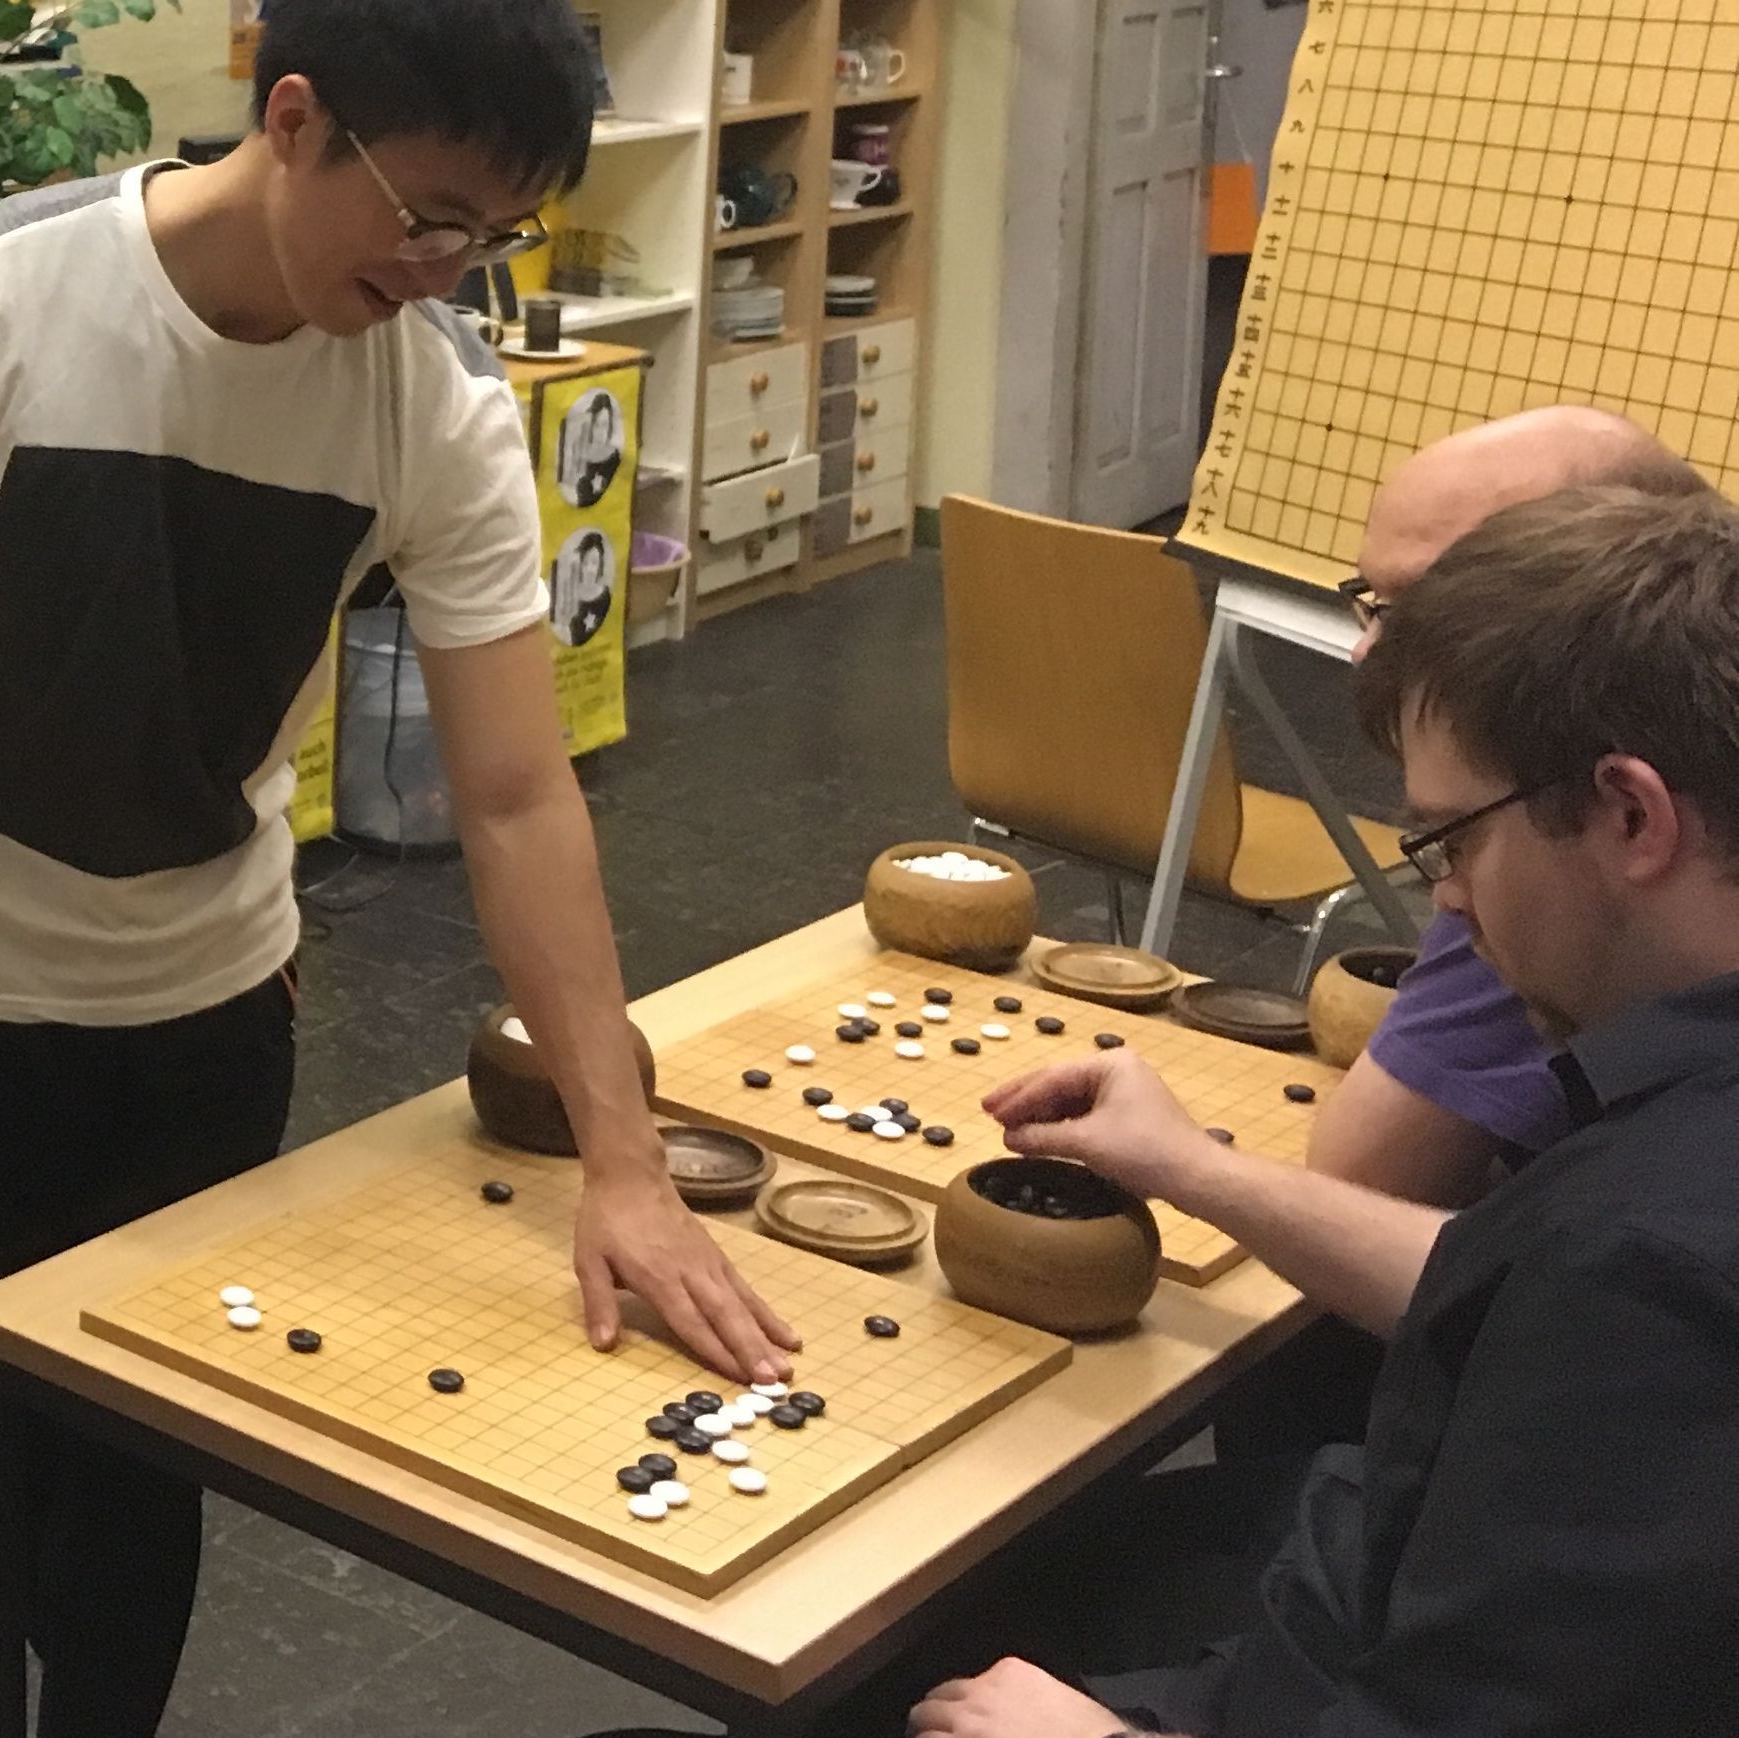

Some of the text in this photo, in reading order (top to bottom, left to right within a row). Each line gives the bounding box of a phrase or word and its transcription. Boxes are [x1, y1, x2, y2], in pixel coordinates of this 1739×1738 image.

[1317, 0, 1334, 14] 六
[1308, 41, 1326, 54] 七
[1298, 78, 1314, 94] 八
[1289, 119, 1305, 133] 九
[1278, 161, 1295, 175] 十
[1272, 195, 1290, 216] 十一
[1261, 232, 1280, 260] 十二
[1223, 387, 1246, 419] 十六
[1215, 430, 1236, 458] 十七
[1201, 468, 1224, 498] 十八
